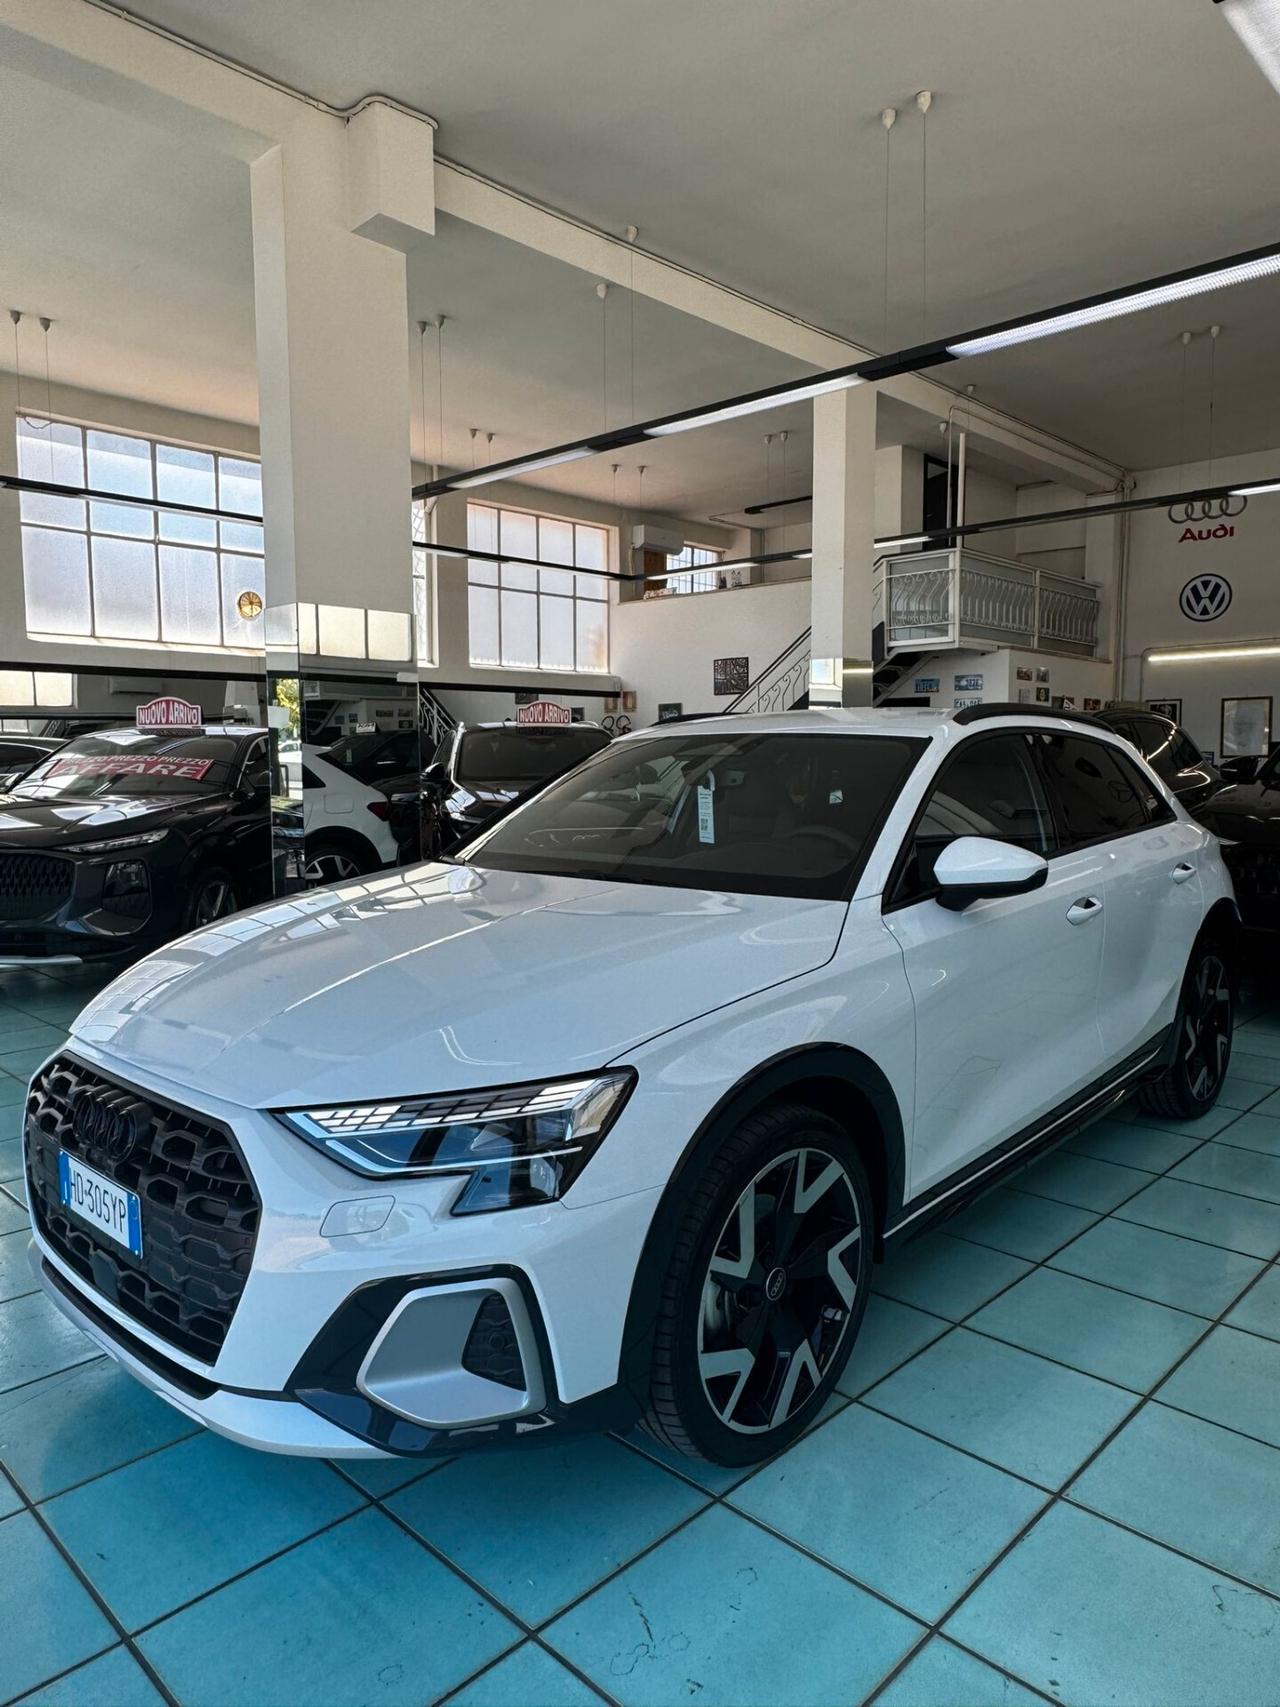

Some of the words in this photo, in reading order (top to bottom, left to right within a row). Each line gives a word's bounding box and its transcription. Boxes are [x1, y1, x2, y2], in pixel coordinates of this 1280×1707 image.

[1178, 524, 1235, 543] Audi
[139, 700, 167, 724] NUOVO
[168, 700, 198, 724] ARRIVO
[520, 703, 543, 722] NUOVO
[544, 703, 569, 723] ARRIVO
[52, 762, 198, 777] AFFARE
[106, 755, 157, 763] PREZZO
[157, 756, 209, 765] PREZZO
